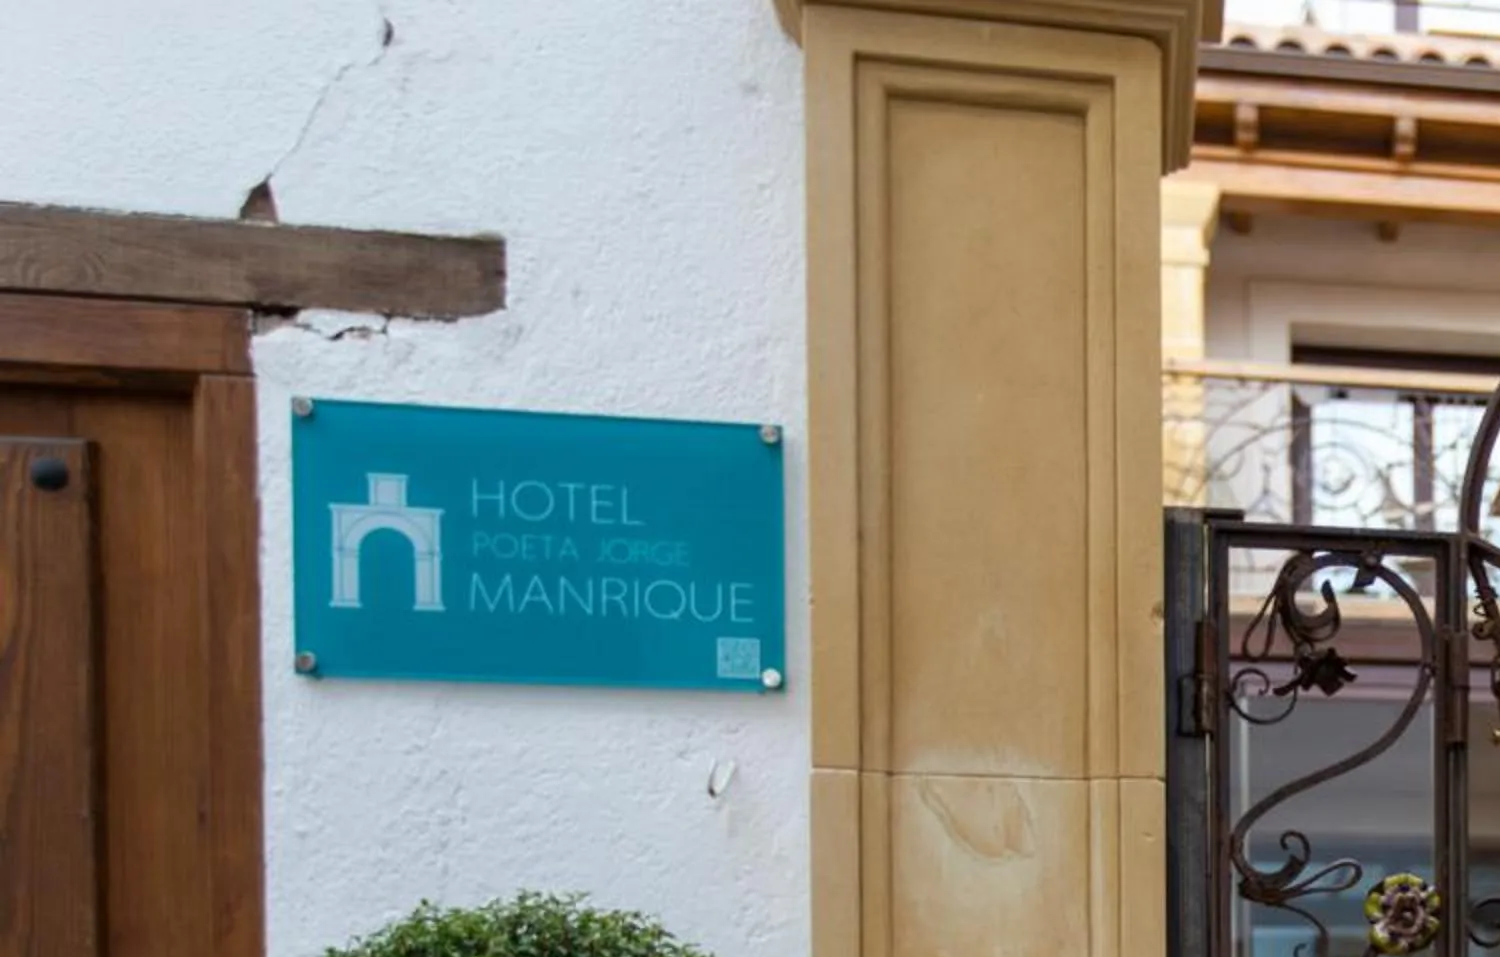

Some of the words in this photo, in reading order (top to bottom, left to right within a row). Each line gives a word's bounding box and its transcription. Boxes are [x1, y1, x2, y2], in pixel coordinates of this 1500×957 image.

[472, 478, 645, 525] HOTEL
[472, 529, 580, 562] POETA
[596, 537, 691, 568] JORGE
[470, 572, 754, 623] MANRIQUE
